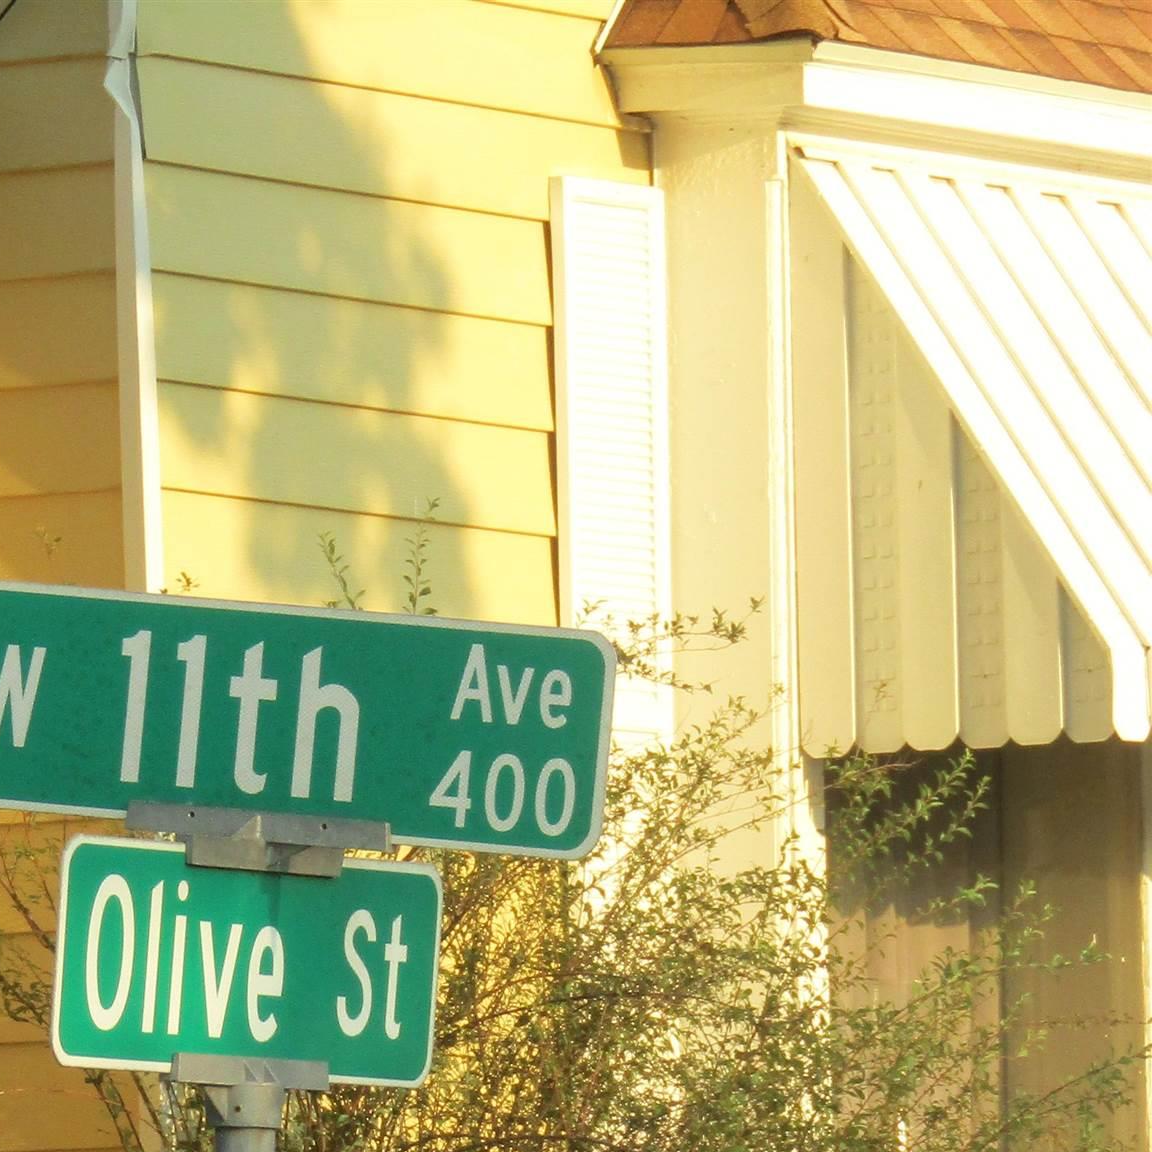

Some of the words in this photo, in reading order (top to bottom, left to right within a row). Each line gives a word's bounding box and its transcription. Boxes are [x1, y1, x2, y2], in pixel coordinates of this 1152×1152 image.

[120, 629, 361, 803] 11th
[450, 643, 573, 729] Ave
[428, 749, 577, 837] 400
[85, 873, 286, 1043] Olive
[336, 908, 408, 1040] St
